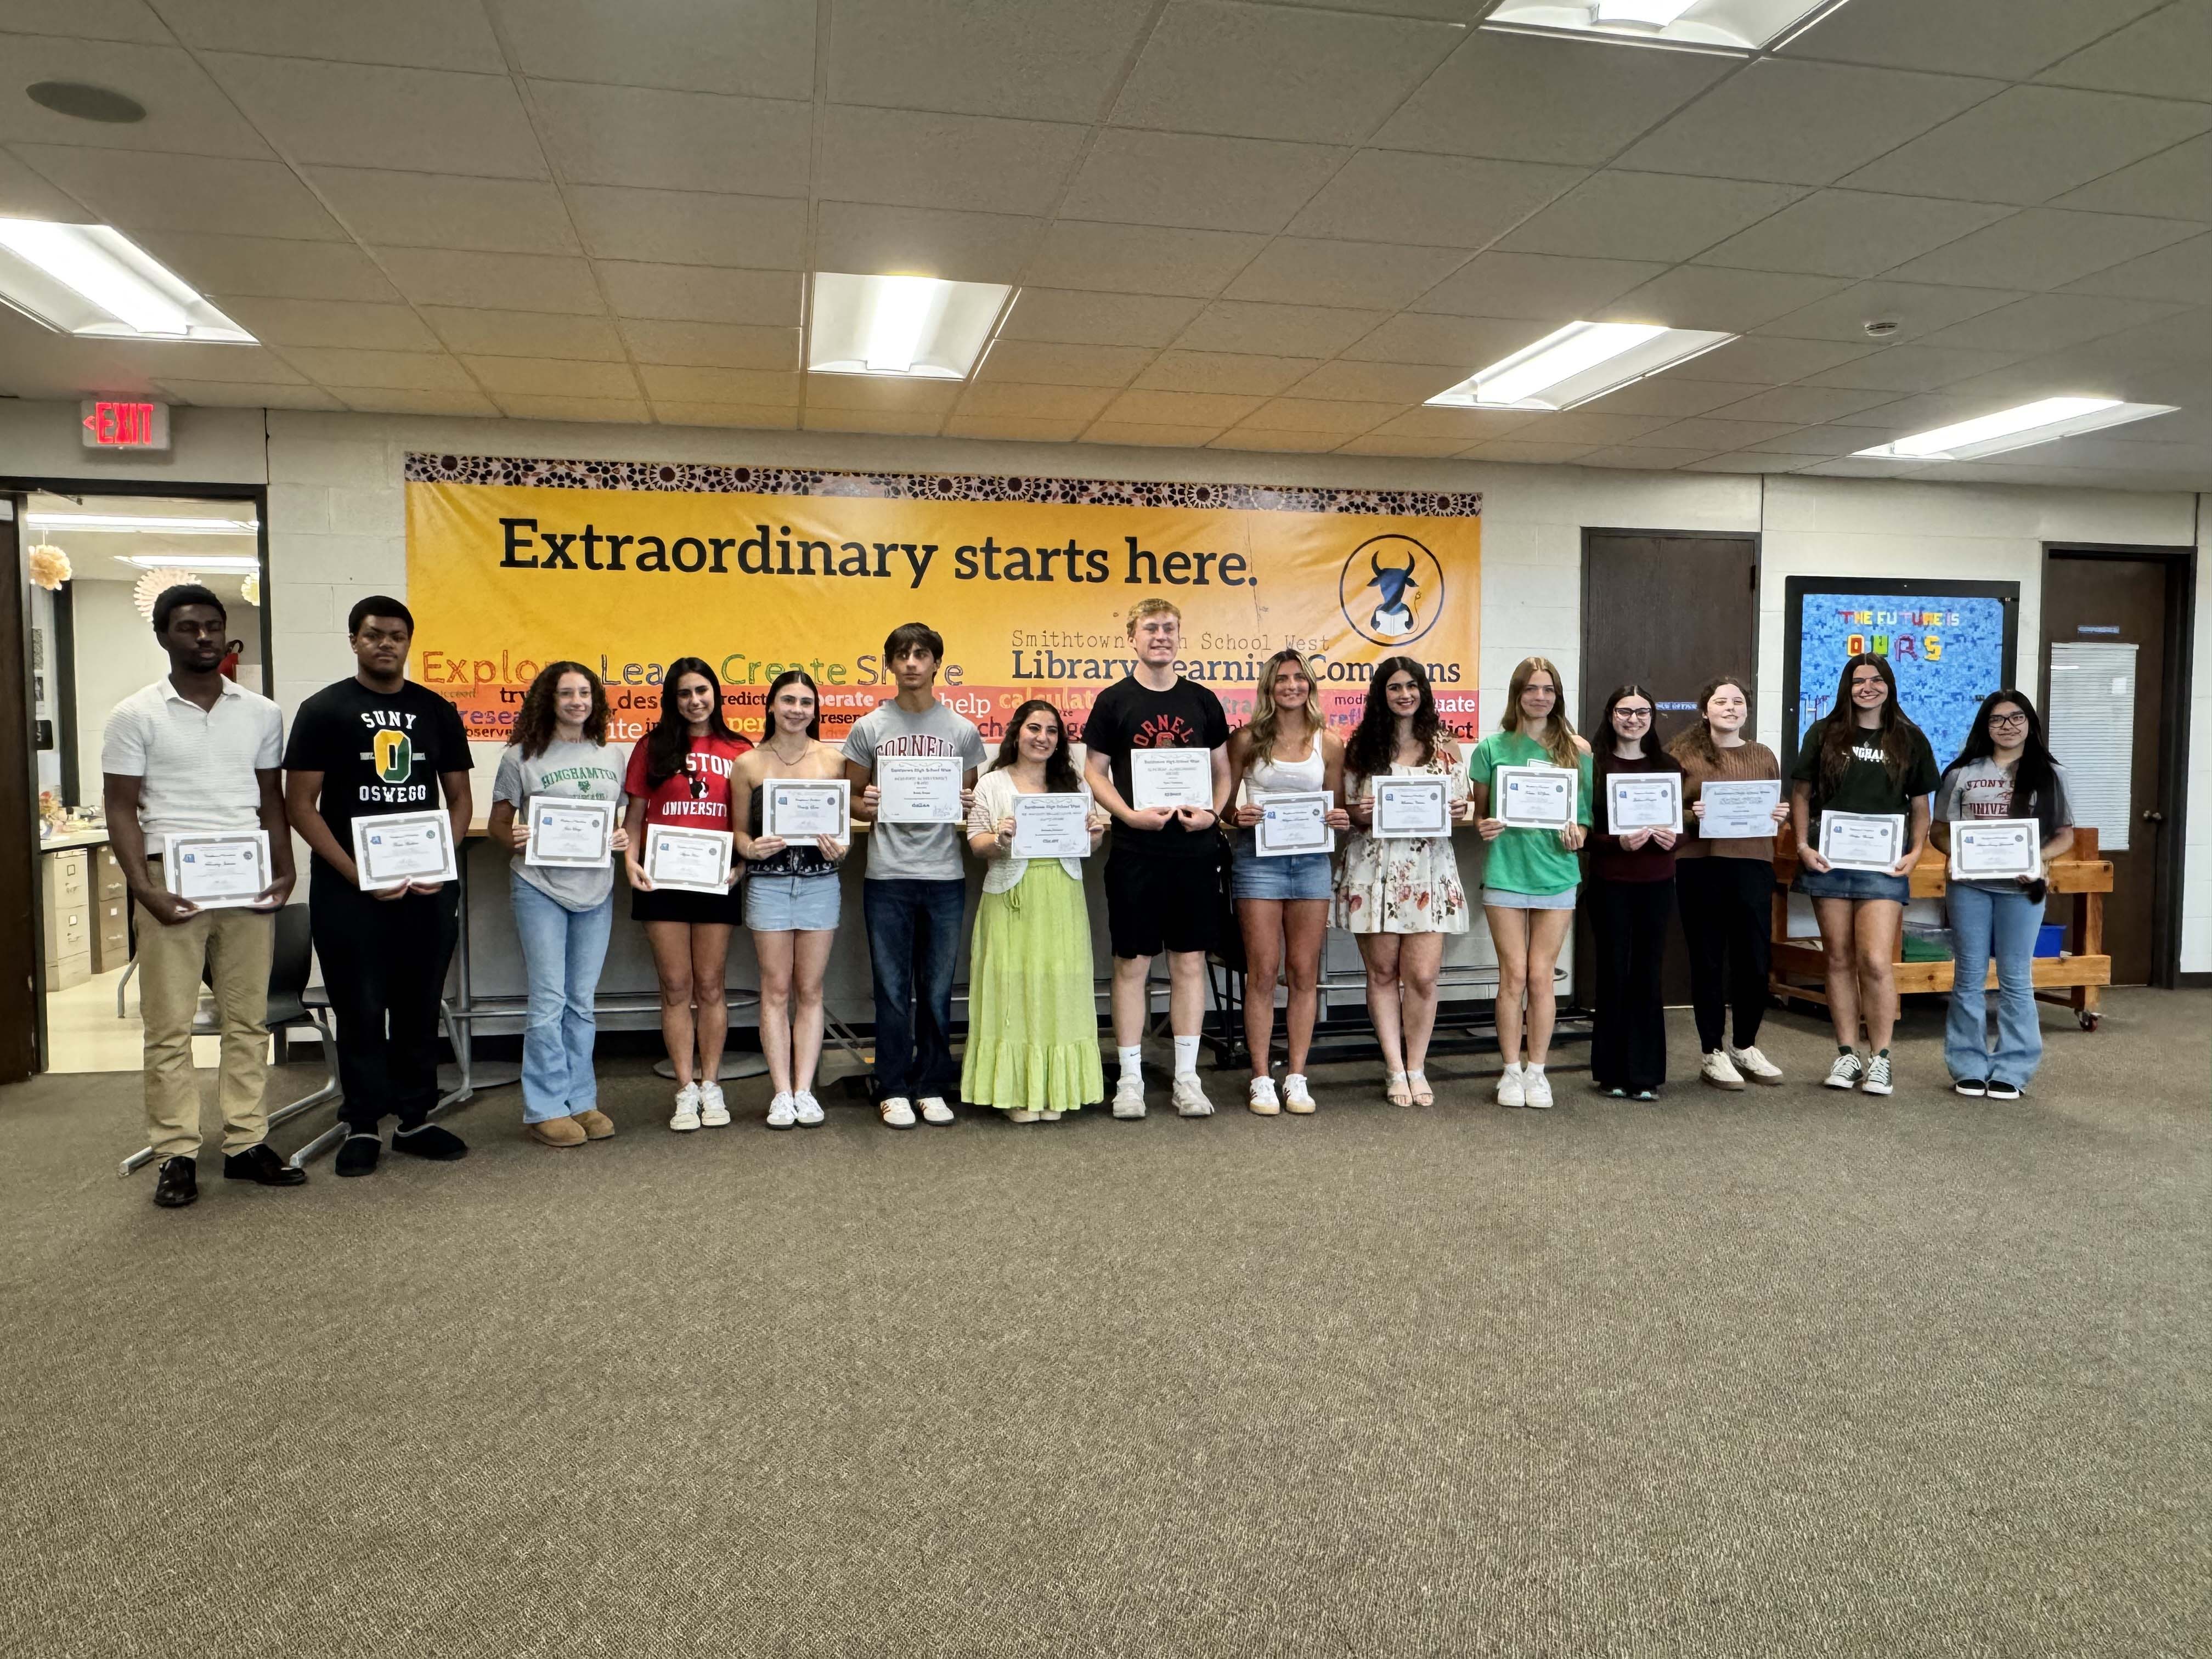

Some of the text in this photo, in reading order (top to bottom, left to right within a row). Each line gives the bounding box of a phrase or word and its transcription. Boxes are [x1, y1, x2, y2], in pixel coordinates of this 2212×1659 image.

[95, 402, 154, 444] EXIT
[499, 518, 1257, 588] Extraordinary starts here.
[1838, 610, 1872, 626] THE
[1945, 610, 1960, 627] IS
[1012, 630, 1124, 648] Smithtown
[1201, 632, 1271, 650] School
[1285, 635, 1330, 651] West
[1847, 633, 1943, 661] OURS
[423, 650, 557, 693] Explo
[601, 654, 664, 685] Lea
[1012, 650, 1461, 683] Library earni Comns
[721, 692, 769, 706] redict
[939, 693, 991, 718] help
[999, 686, 1095, 710] calculat
[360, 710, 416, 729] SUNY
[1133, 714, 1194, 747] ORNEL
[686, 753, 733, 779] STON
[359, 785, 426, 803] OSWEGO
[1966, 779, 2005, 791] STONY
